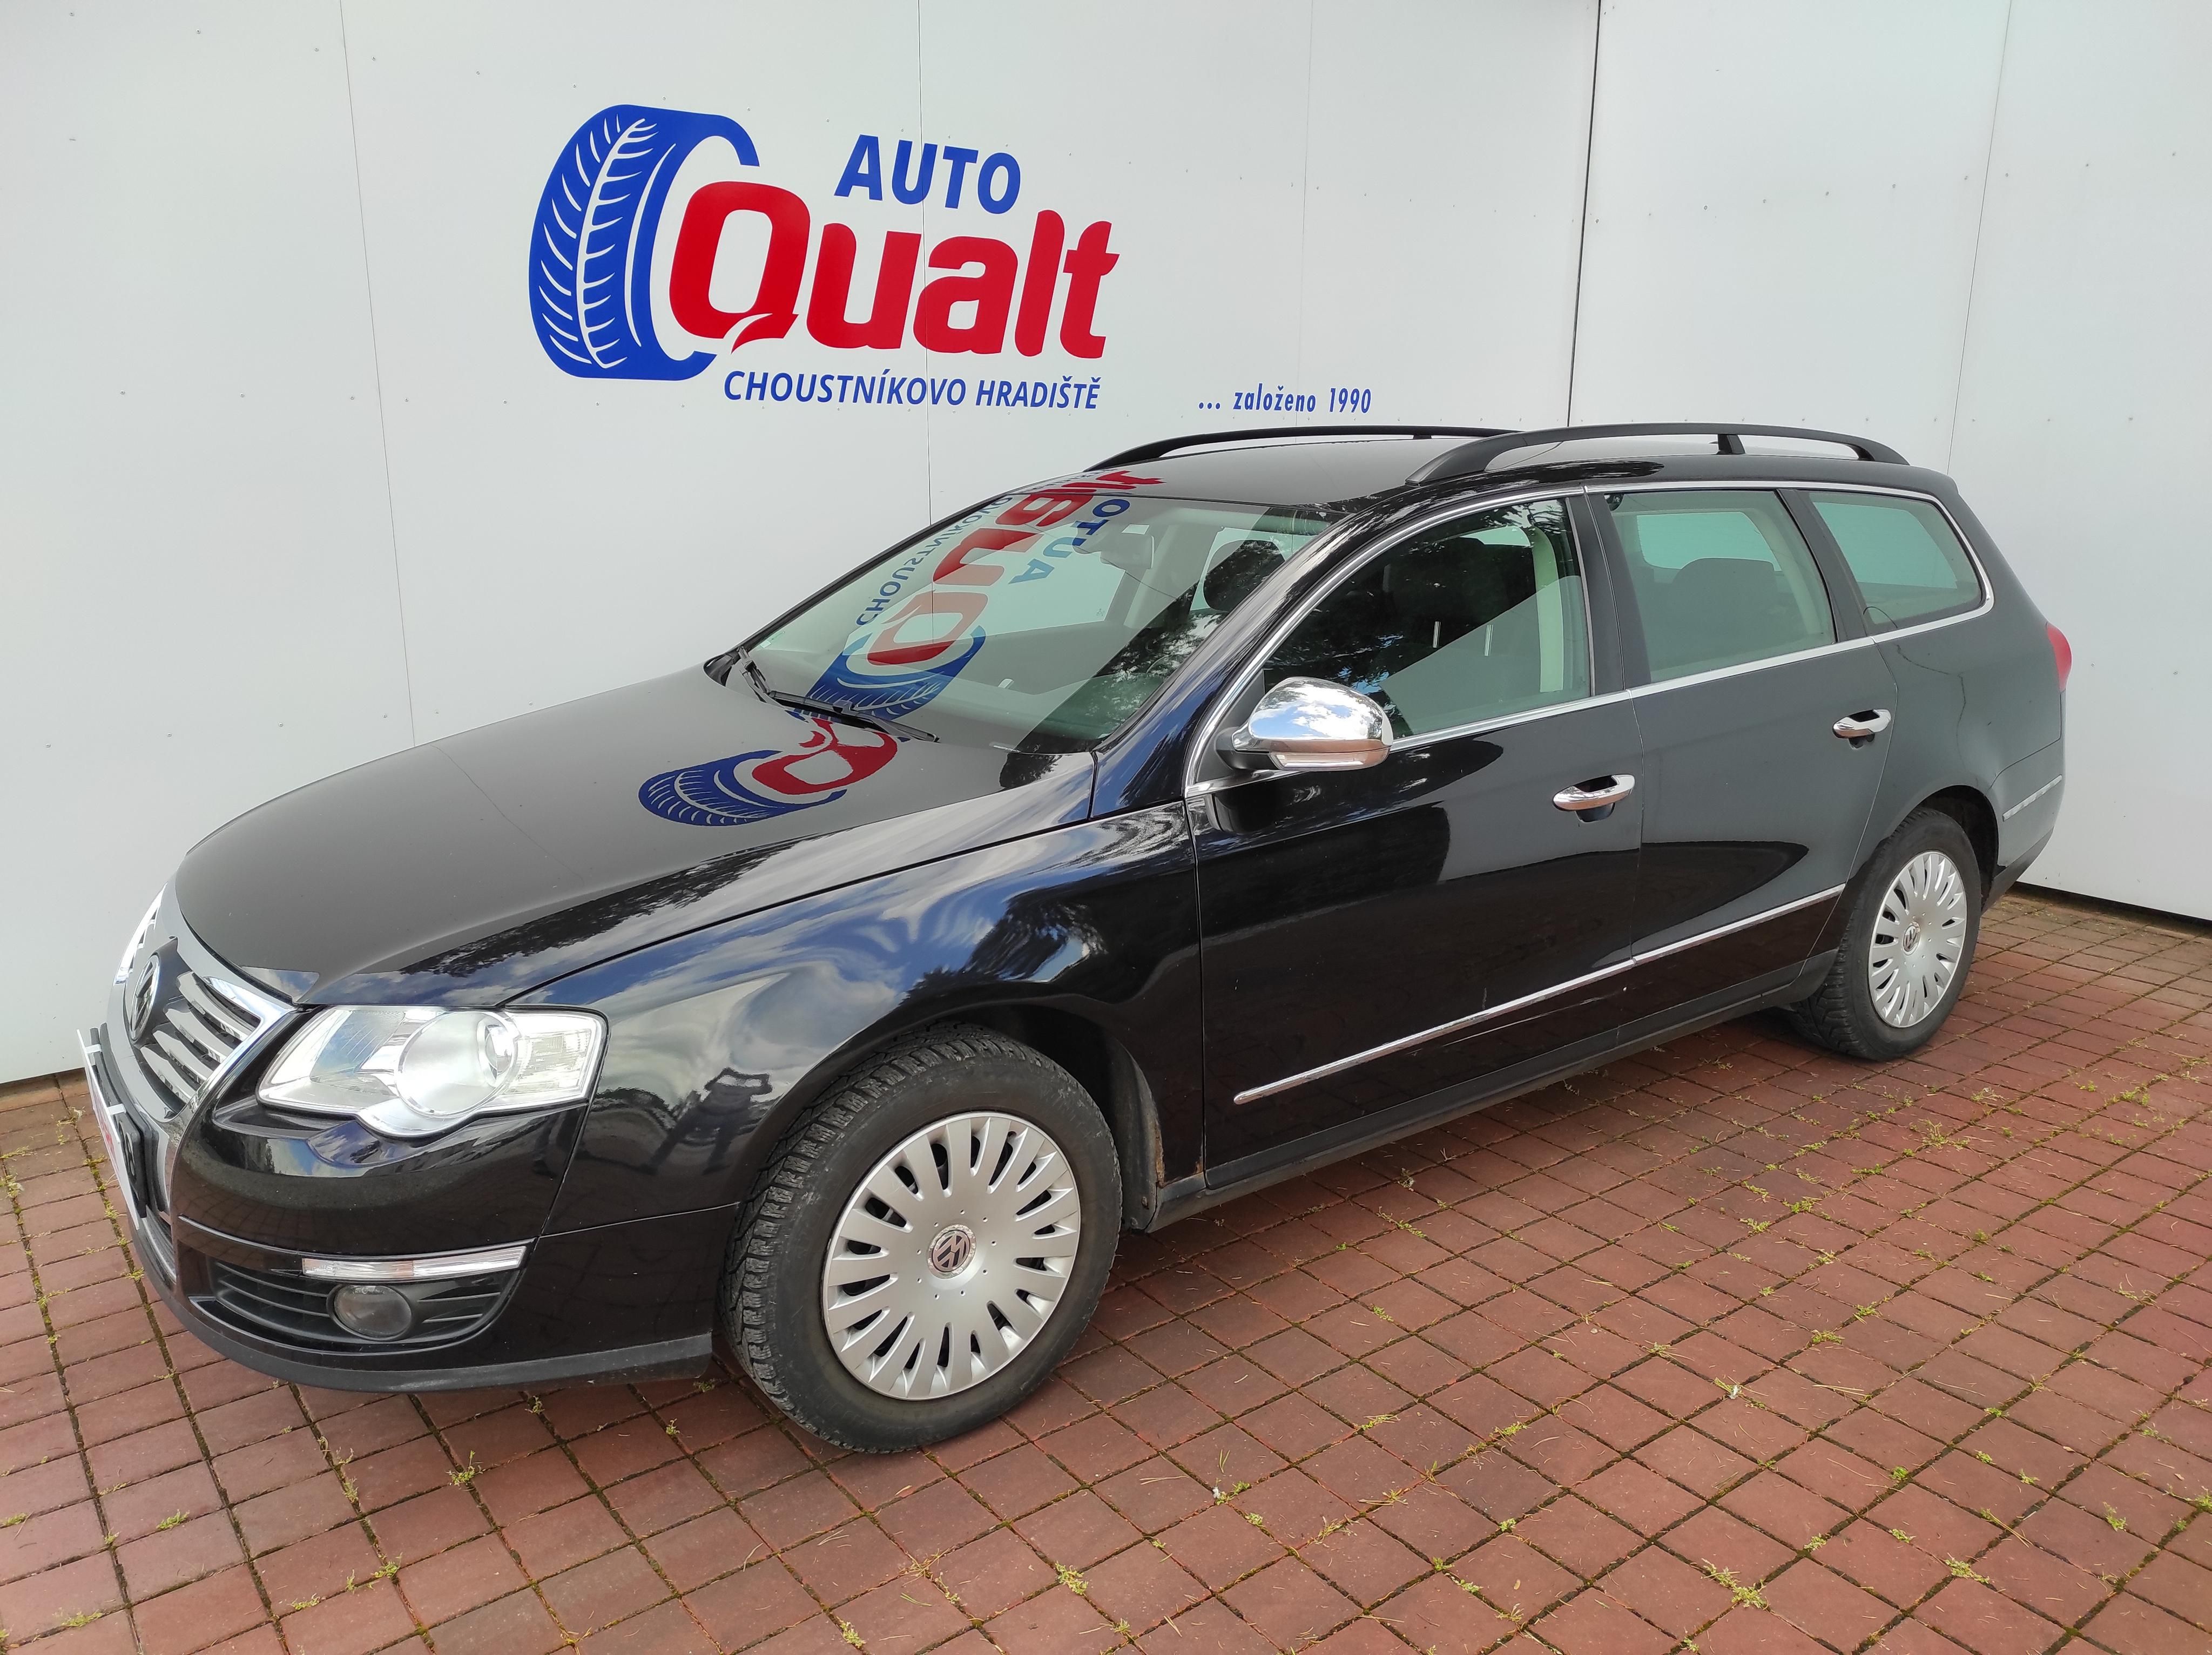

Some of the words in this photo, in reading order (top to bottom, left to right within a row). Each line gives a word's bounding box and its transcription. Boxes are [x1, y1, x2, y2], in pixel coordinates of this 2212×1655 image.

[834, 134, 1021, 215] AUTO
[669, 180, 1120, 360] Qualt
[724, 369, 966, 406] CHOUSTNÍKOVO
[975, 375, 1101, 409] HRADIŠTĚ
[1233, 383, 1316, 412] založeno
[1330, 388, 1372, 414] 1990
